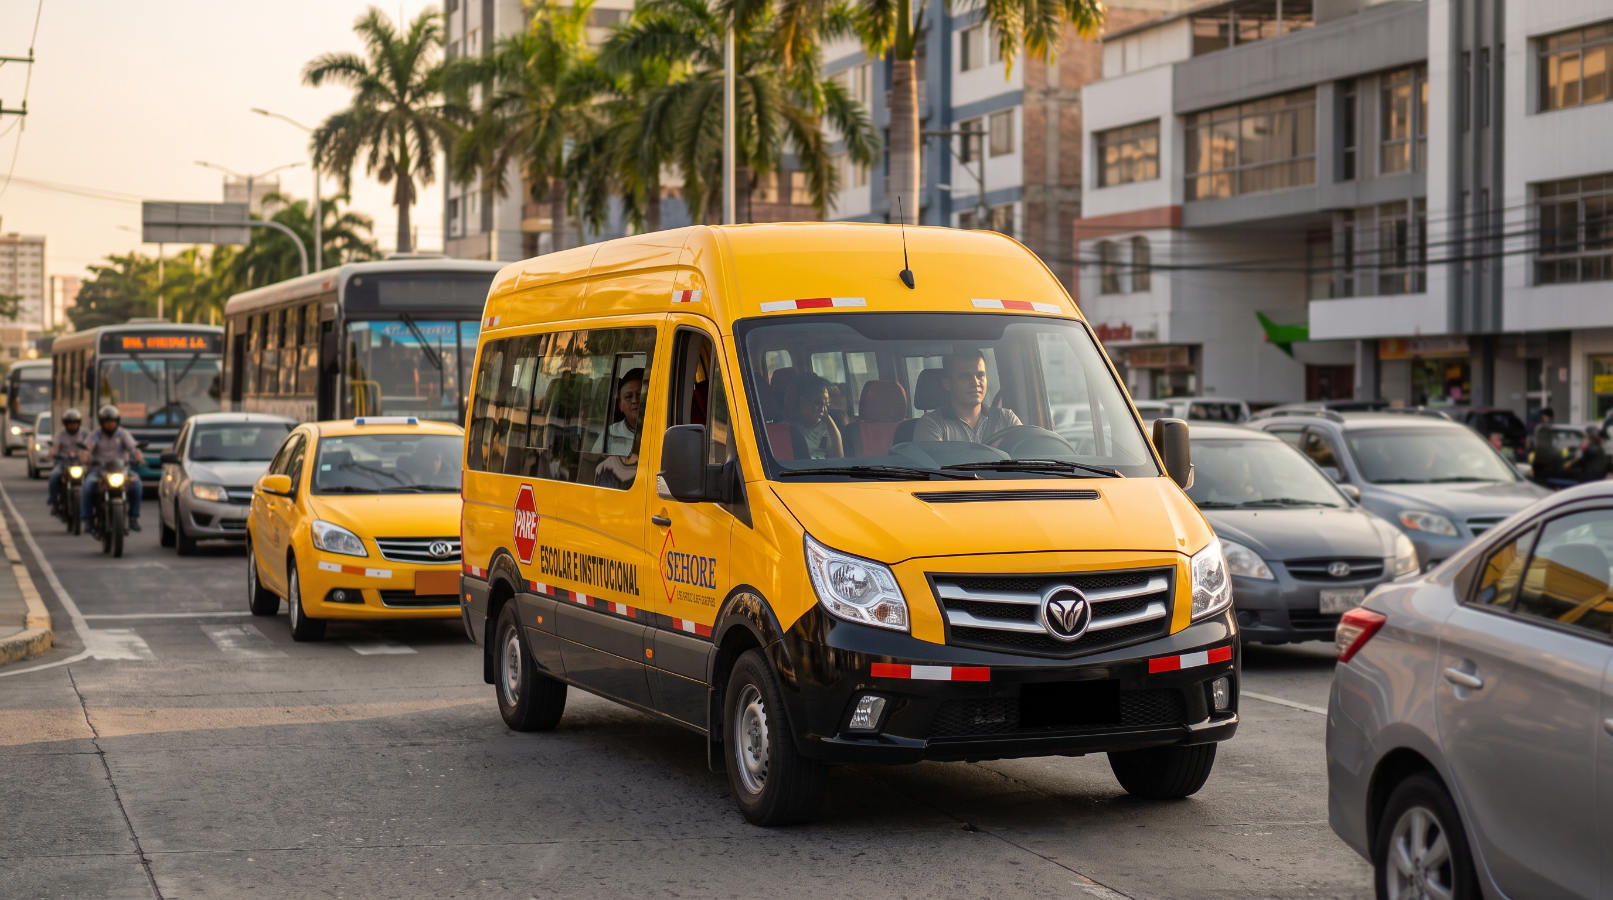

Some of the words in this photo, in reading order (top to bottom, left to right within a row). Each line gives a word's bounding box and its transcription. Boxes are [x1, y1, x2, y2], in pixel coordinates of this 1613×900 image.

[514, 508, 537, 540] PARE
[540, 545, 572, 581] ESCOLAR
[573, 551, 579, 582] E
[580, 552, 640, 597] INSTITUCIONAL
[666, 550, 717, 590] SEHORE
